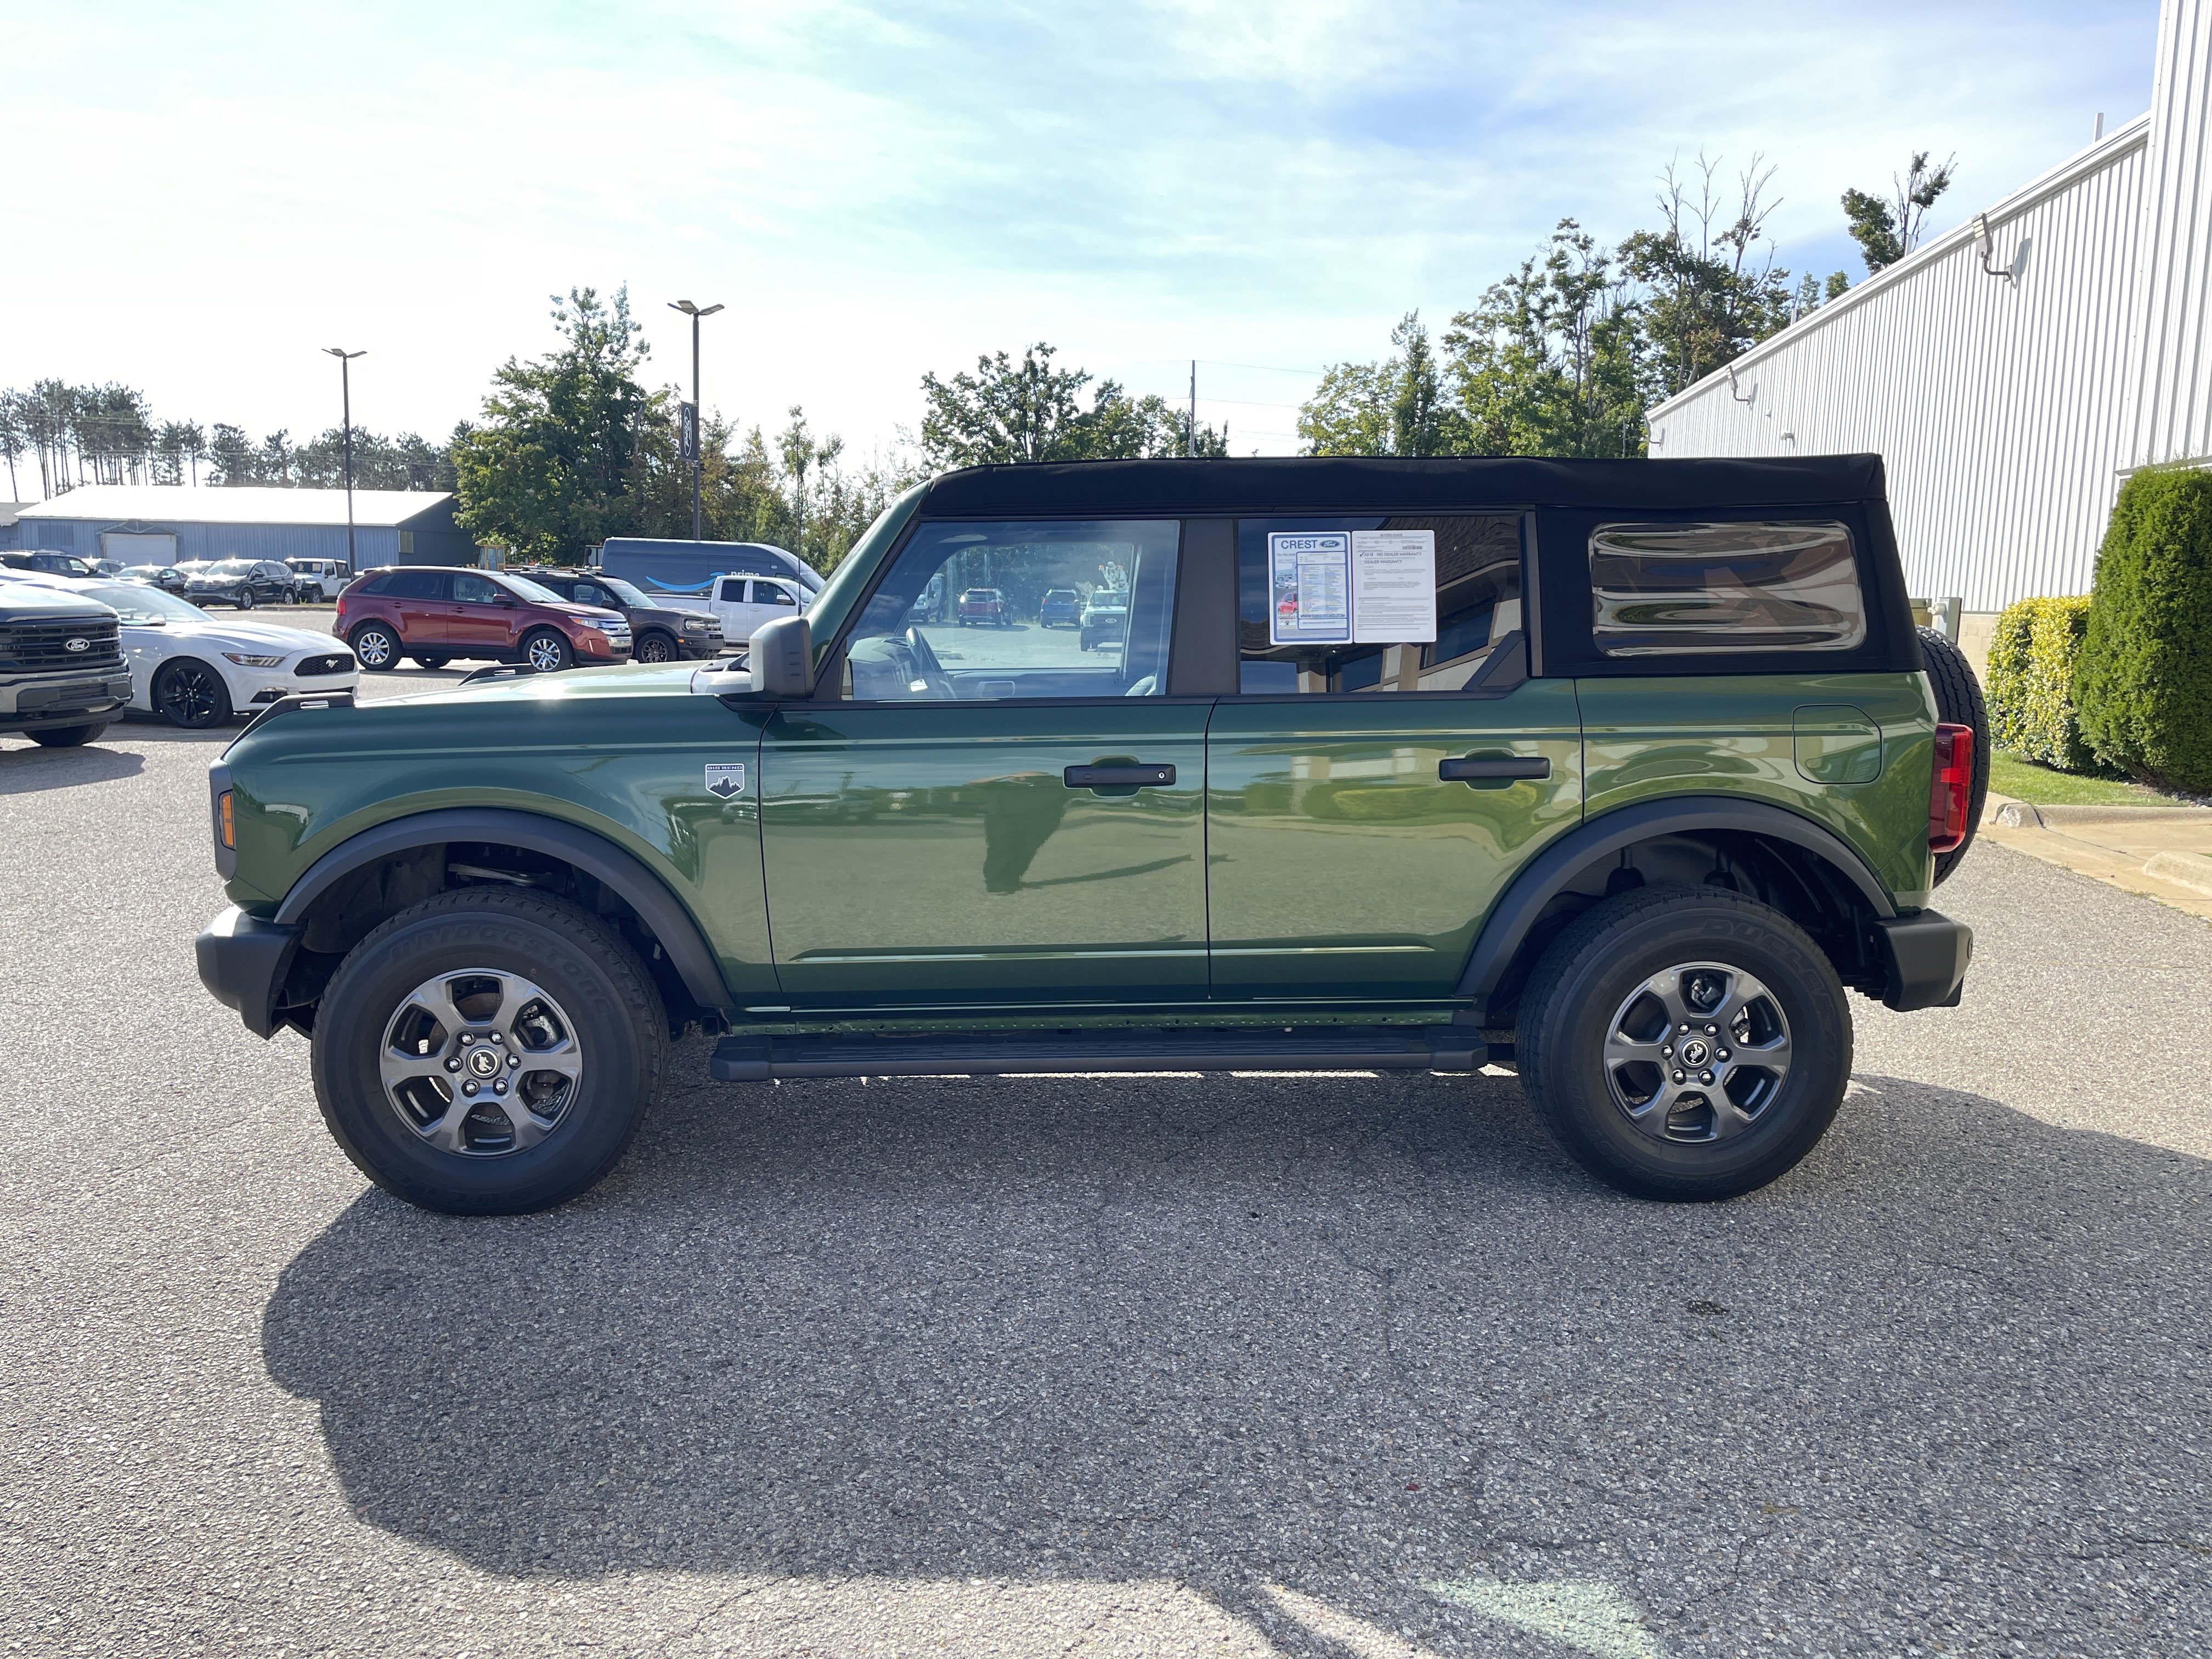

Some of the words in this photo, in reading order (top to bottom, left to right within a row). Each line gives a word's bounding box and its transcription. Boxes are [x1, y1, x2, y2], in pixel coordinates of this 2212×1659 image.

[1281, 540, 1318, 549] CREST
[388, 923, 614, 1015] BRIDGESTONE
[1701, 918, 1836, 1020] DUELER
[1563, 1063, 1735, 1190] BRIDGESTONE
